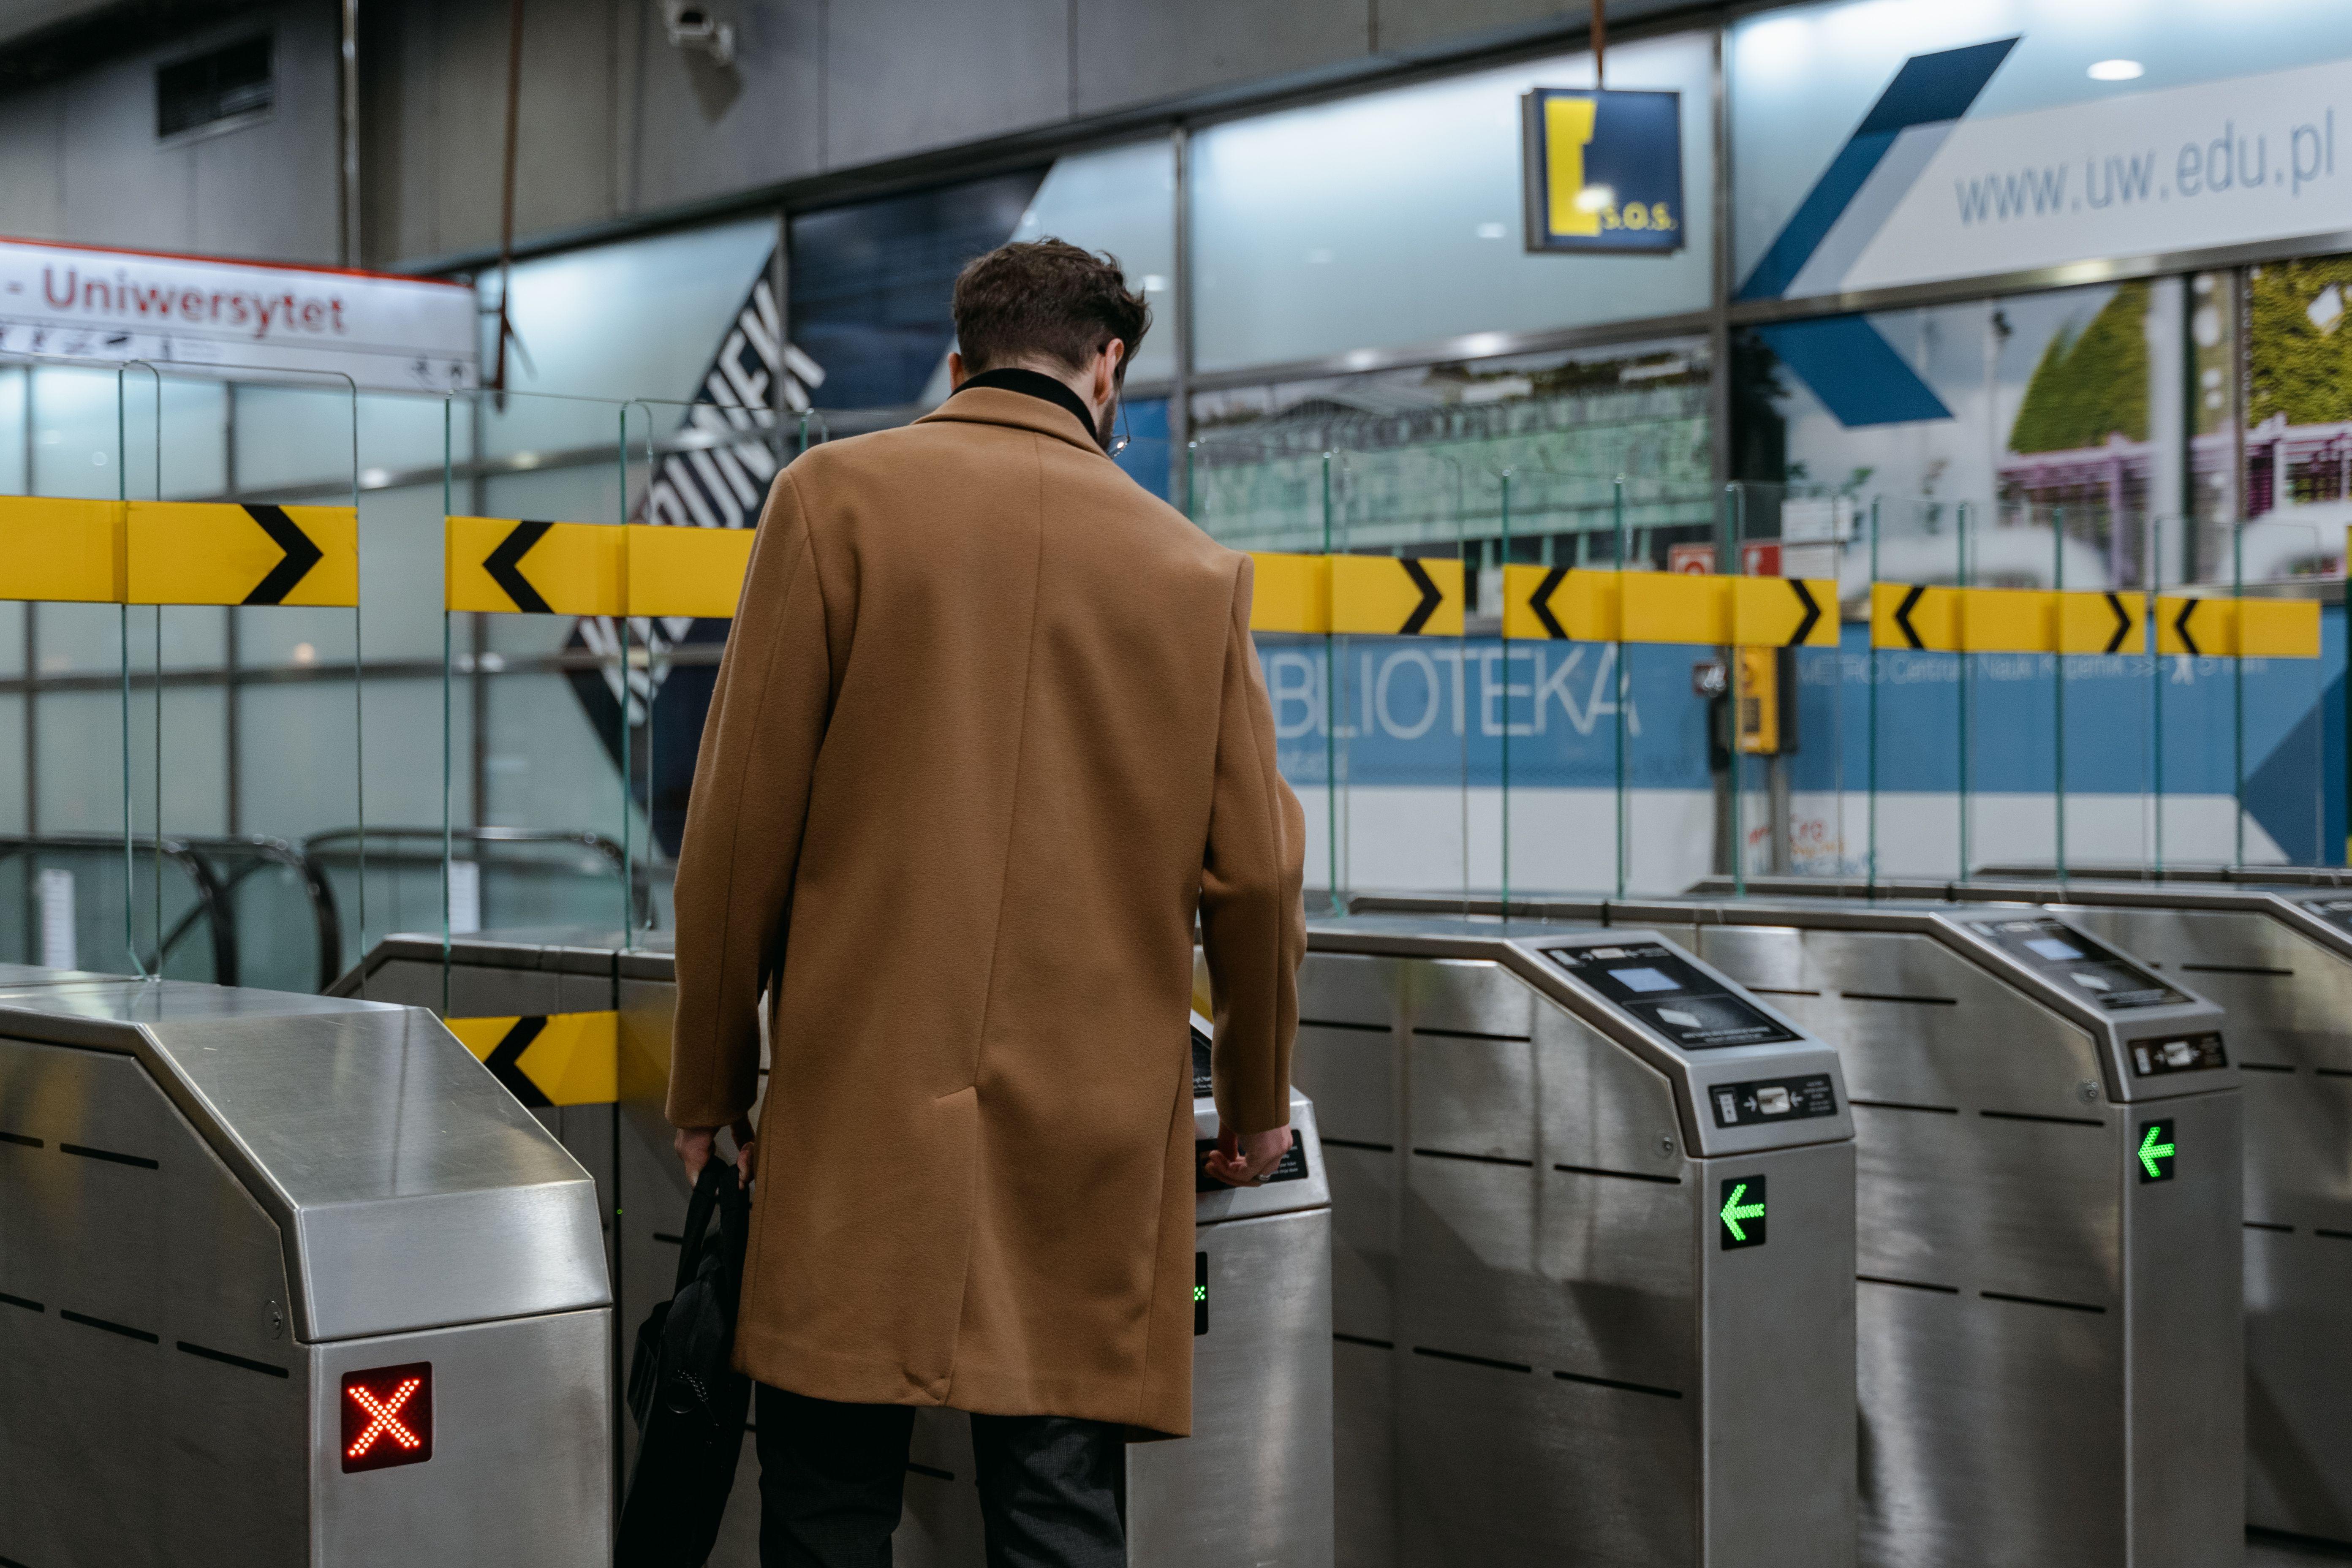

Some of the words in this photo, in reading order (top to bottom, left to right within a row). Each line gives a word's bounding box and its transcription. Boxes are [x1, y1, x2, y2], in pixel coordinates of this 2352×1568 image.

[1954, 106, 2336, 226] www.uw.edu.pl
[42, 266, 348, 338] Uniwersytet
[1260, 644, 1642, 741] BLIOTEKA
